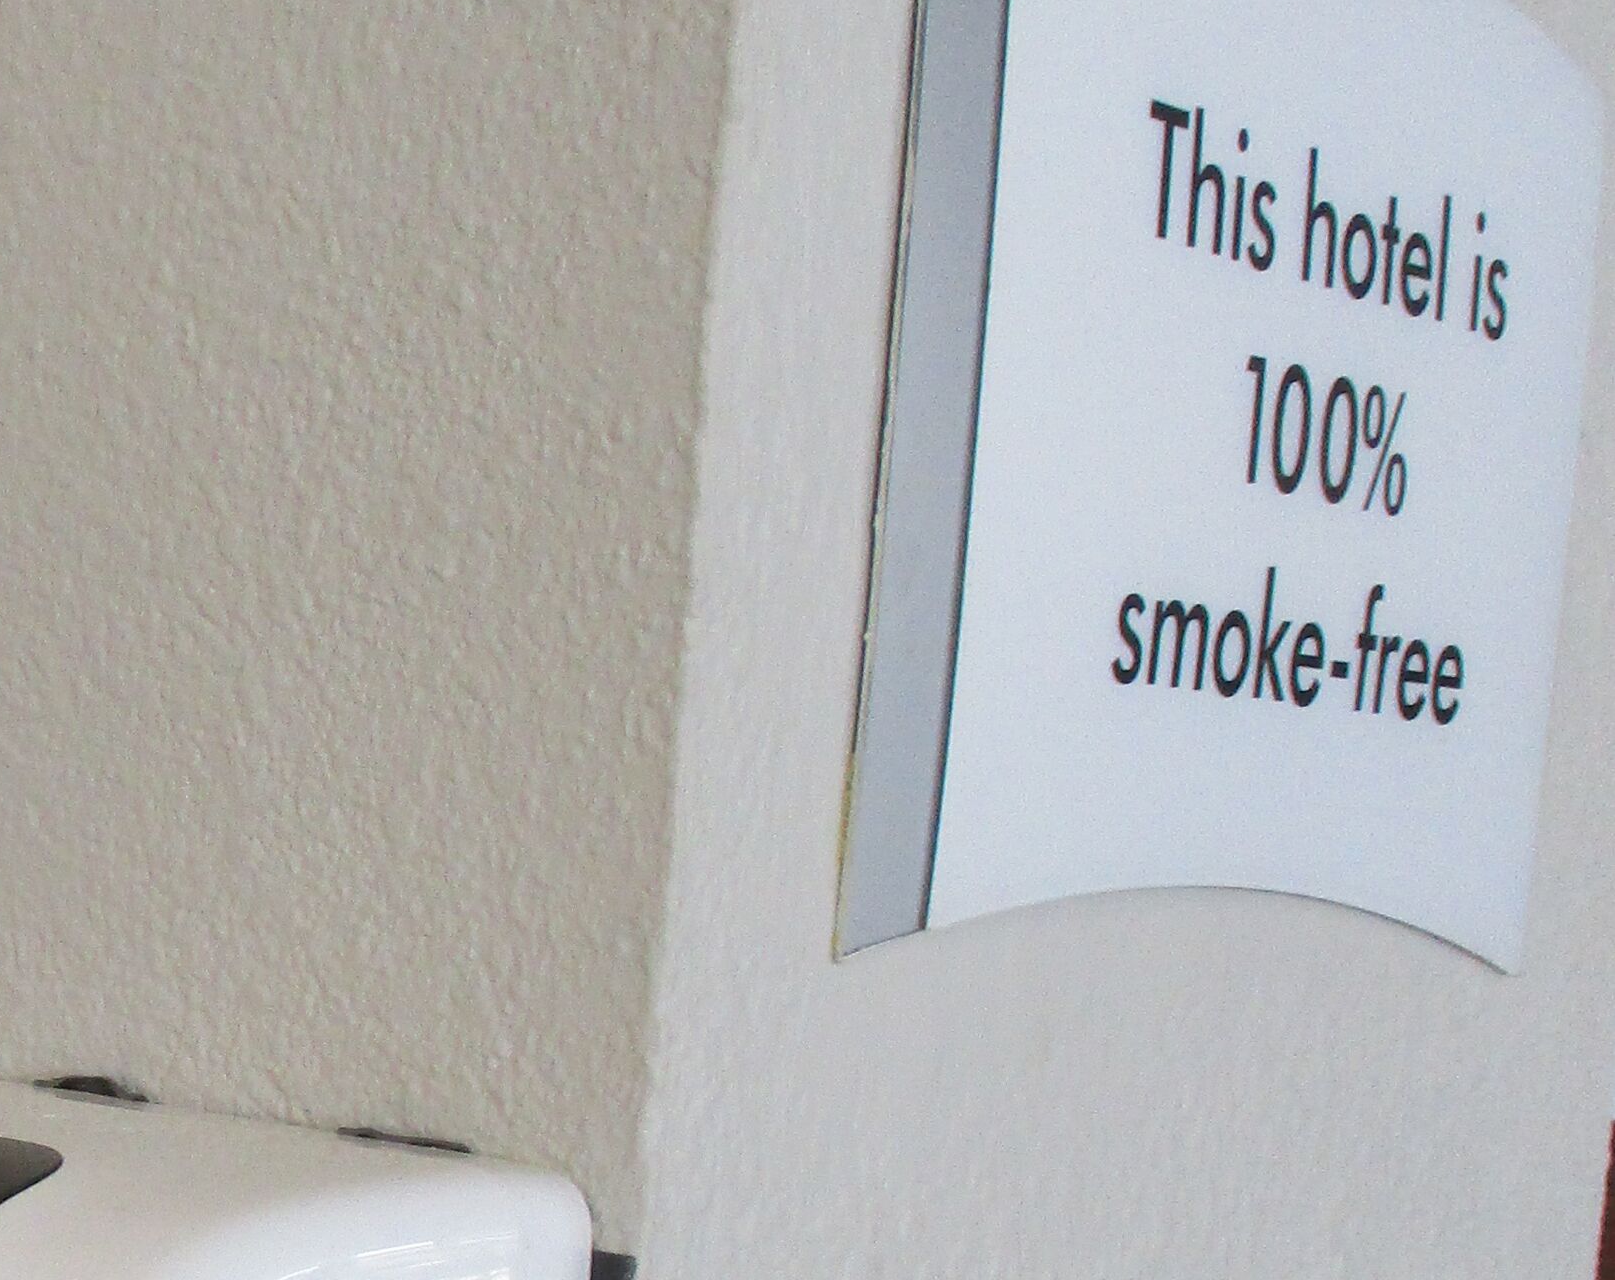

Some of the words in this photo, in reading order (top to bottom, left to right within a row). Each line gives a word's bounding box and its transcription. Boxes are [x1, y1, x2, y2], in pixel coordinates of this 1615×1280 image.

[1150, 99, 1277, 272] This
[1302, 148, 1452, 320] hotel
[1469, 211, 1508, 341] is
[1246, 356, 1408, 517] 100%
[1112, 566, 1464, 724] smoke-free
